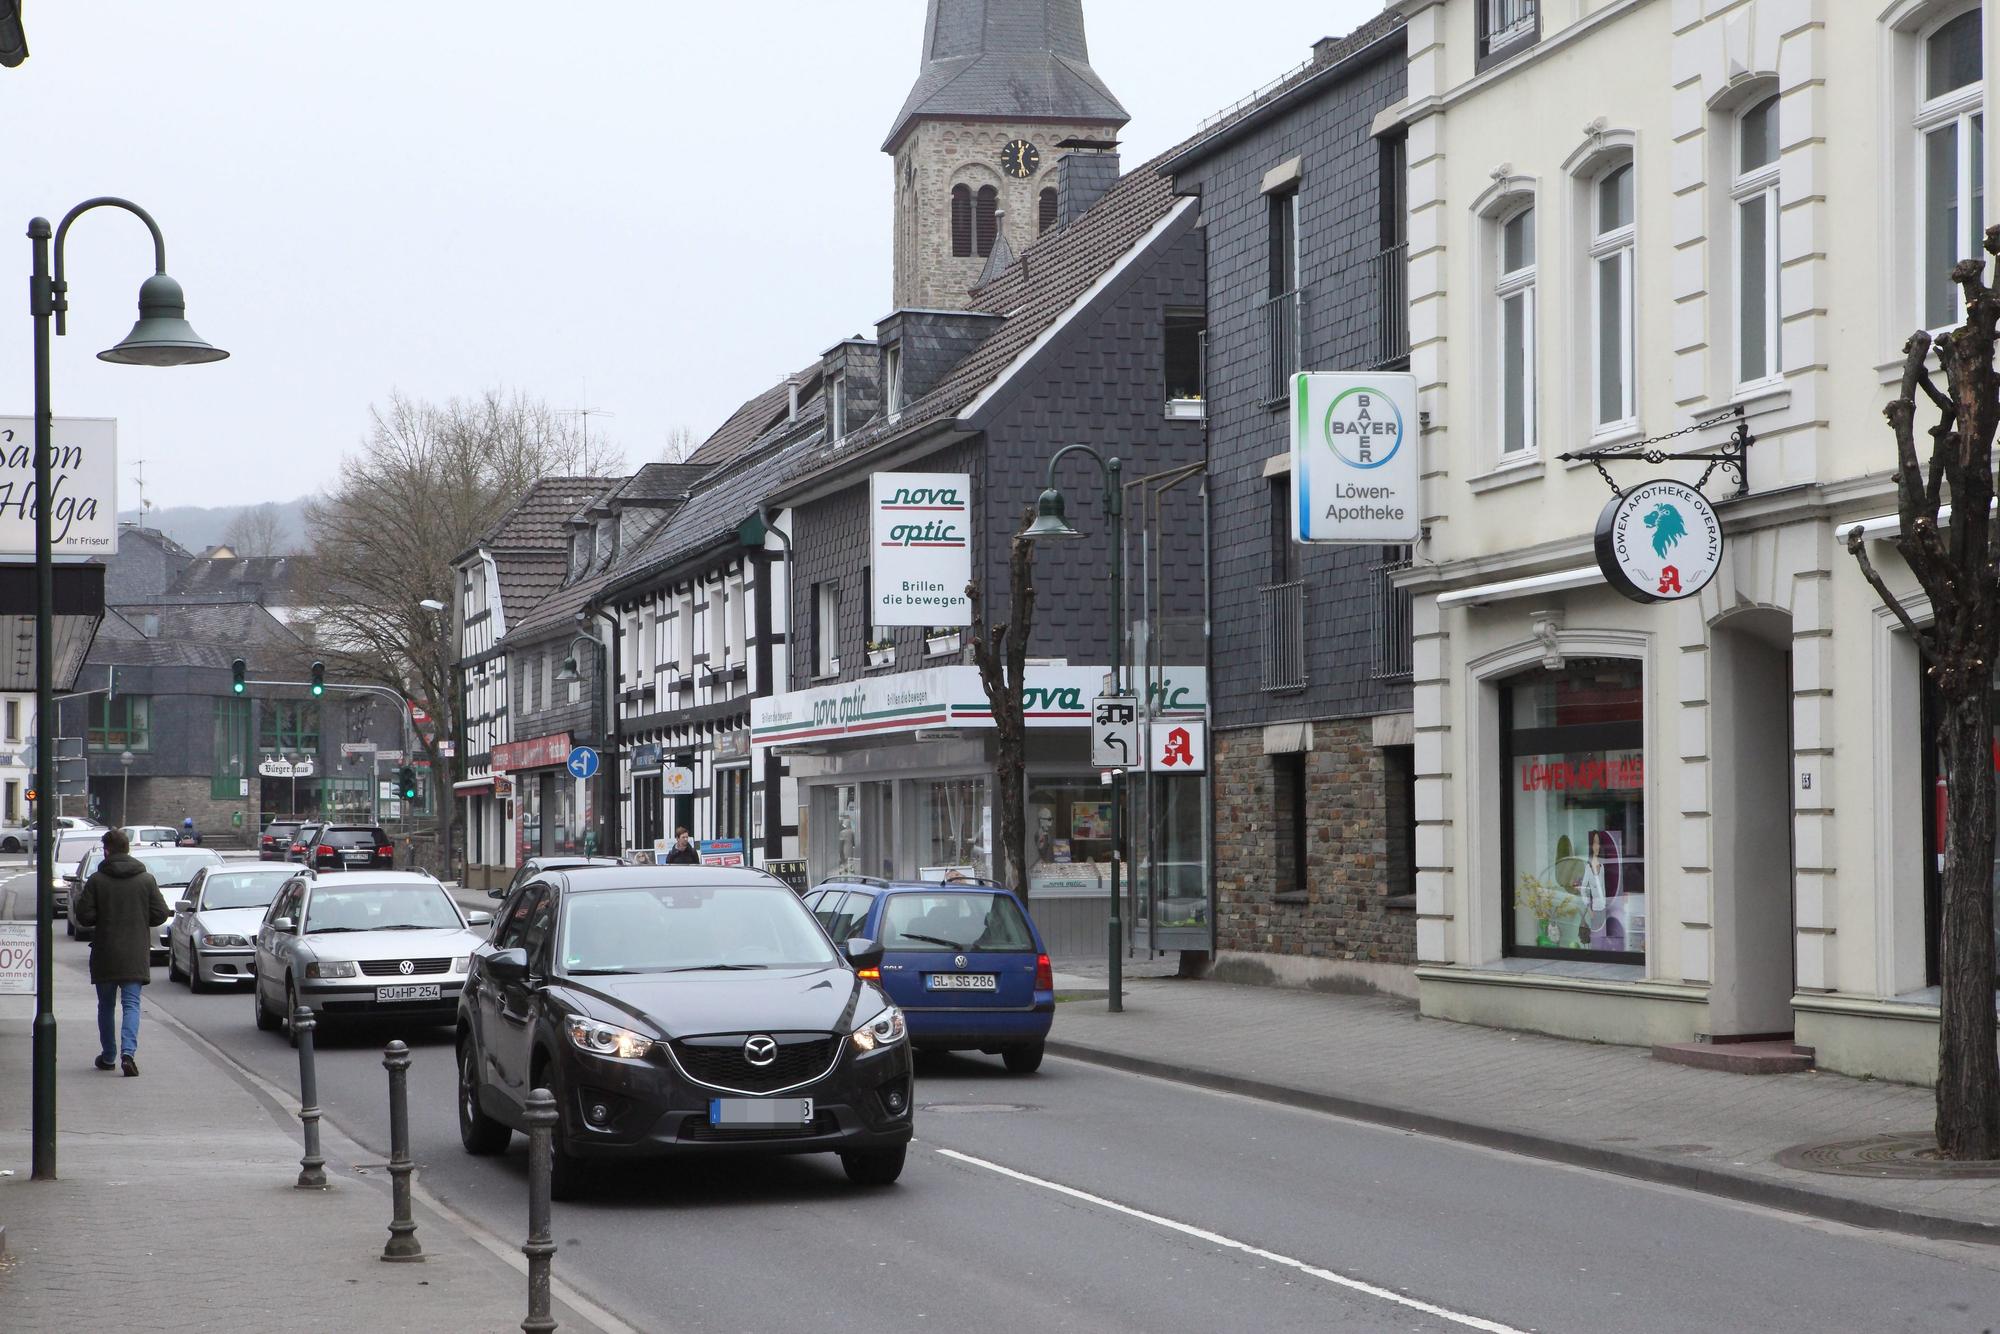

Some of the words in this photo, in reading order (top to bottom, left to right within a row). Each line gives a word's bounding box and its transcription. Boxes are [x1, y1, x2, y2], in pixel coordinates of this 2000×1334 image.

[1332, 421, 1397, 436] BAYER
[881, 488, 965, 505] nova
[1335, 482, 1396, 499] Löwen-
[1325, 504, 1405, 524] Apotheke
[1616, 511, 1631, 563] LÖWEN
[1628, 486, 1694, 512] APOTHEKE
[1694, 500, 1718, 562] OVERATH
[66, 537, 78, 545] Ihr
[80, 536, 110, 546] Friseur
[889, 520, 965, 547] optic
[902, 580, 944, 591] Brillen
[882, 594, 903, 605] die
[906, 594, 965, 608] bewegen
[907, 691, 927, 705] bewegen
[1006, 687, 1085, 710] ova
[813, 697, 838, 726] nova
[839, 685, 867, 730] optic
[768, 862, 806, 873] WENN
[932, 976, 948, 987] GL
[955, 976, 971, 987] SG
[972, 976, 994, 987] 286
[418, 986, 438, 998] 254
